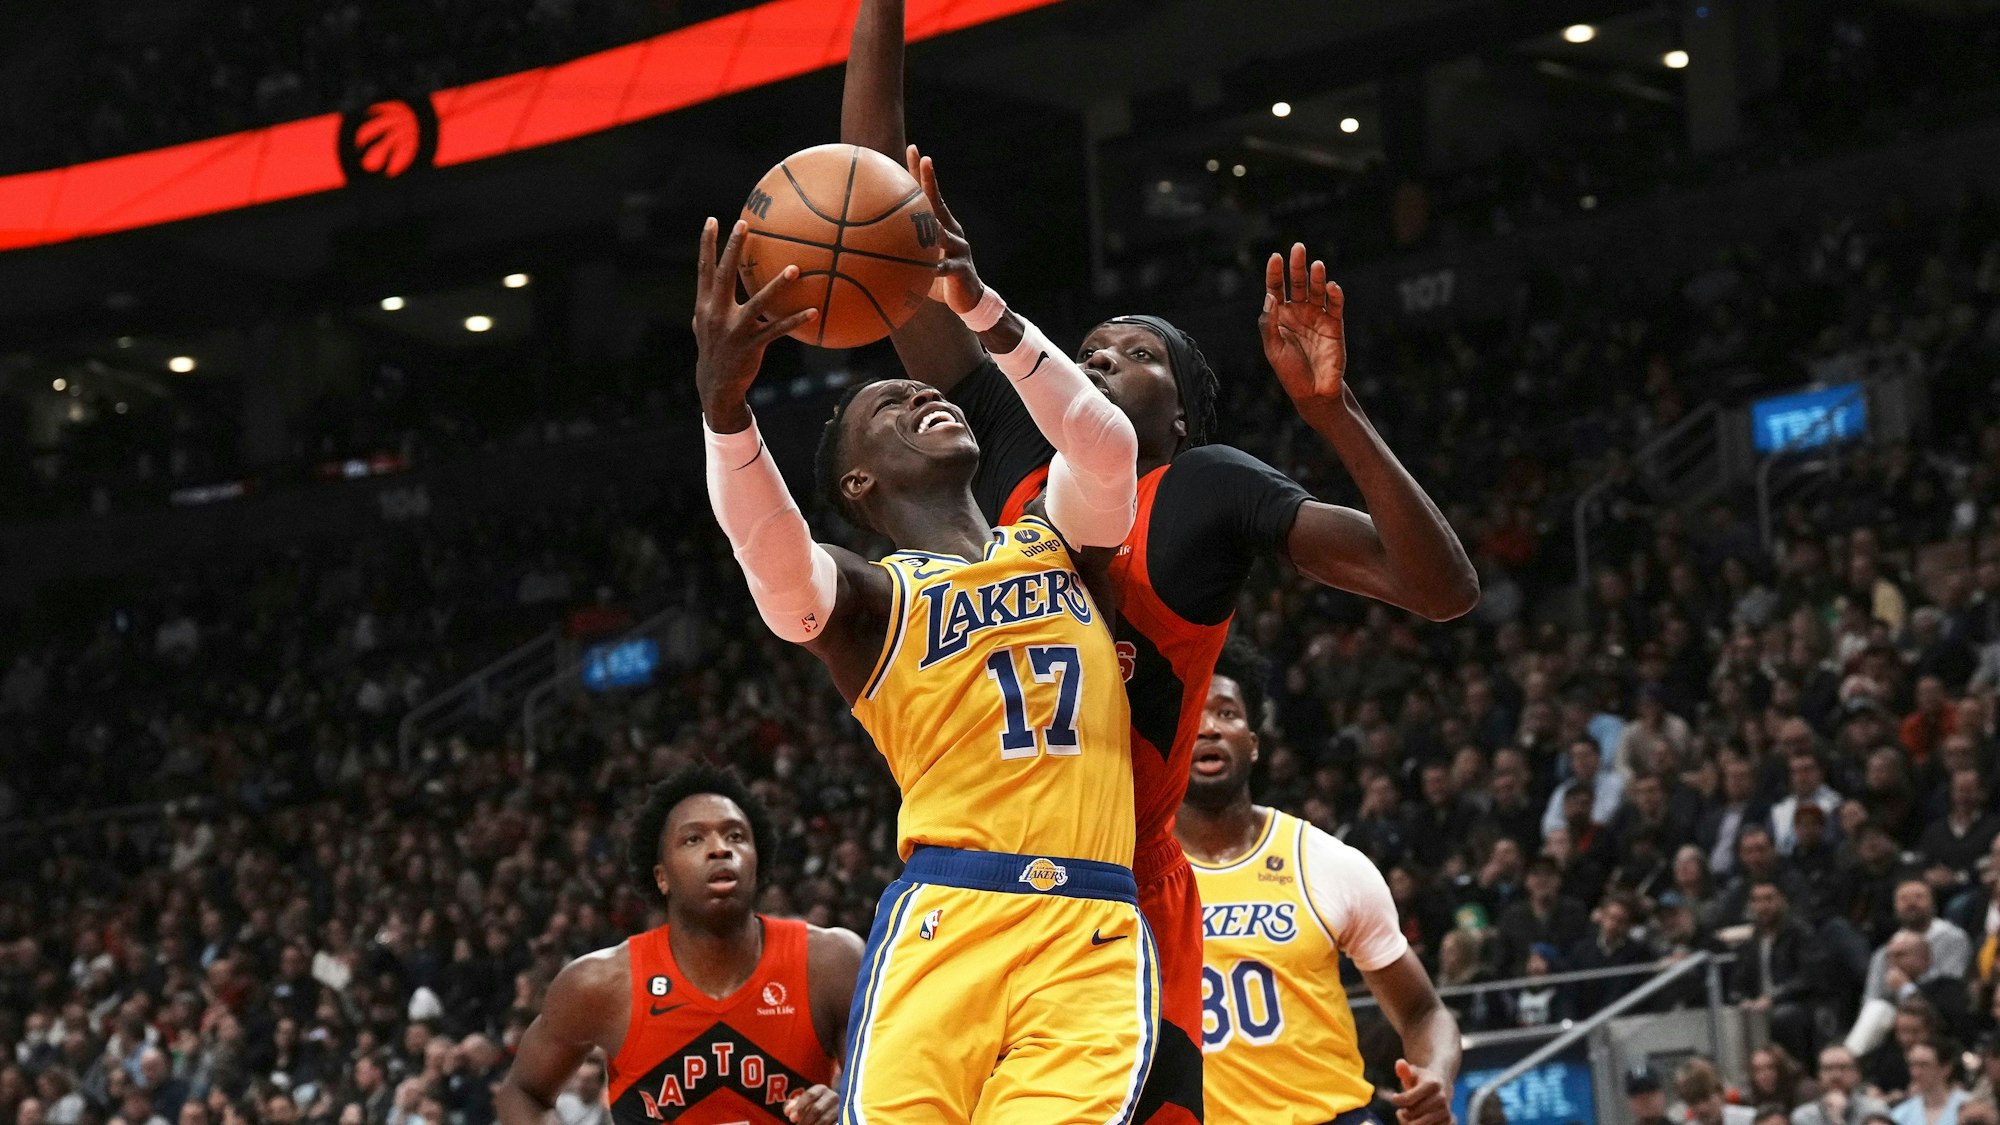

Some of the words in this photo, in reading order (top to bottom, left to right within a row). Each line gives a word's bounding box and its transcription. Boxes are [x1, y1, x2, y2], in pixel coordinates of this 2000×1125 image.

[1399, 270, 1454, 312] 107
[1021, 539, 1061, 557] bibigo
[1115, 544, 1131, 556] ife
[918, 570, 1092, 672] LAKERS
[985, 645, 1082, 760] 17
[1022, 865, 1068, 885] LAKERS
[1258, 872, 1294, 885] bibigo
[651, 976, 668, 996] 6
[757, 1006, 775, 1016] Sun
[776, 1005, 795, 1016] Life
